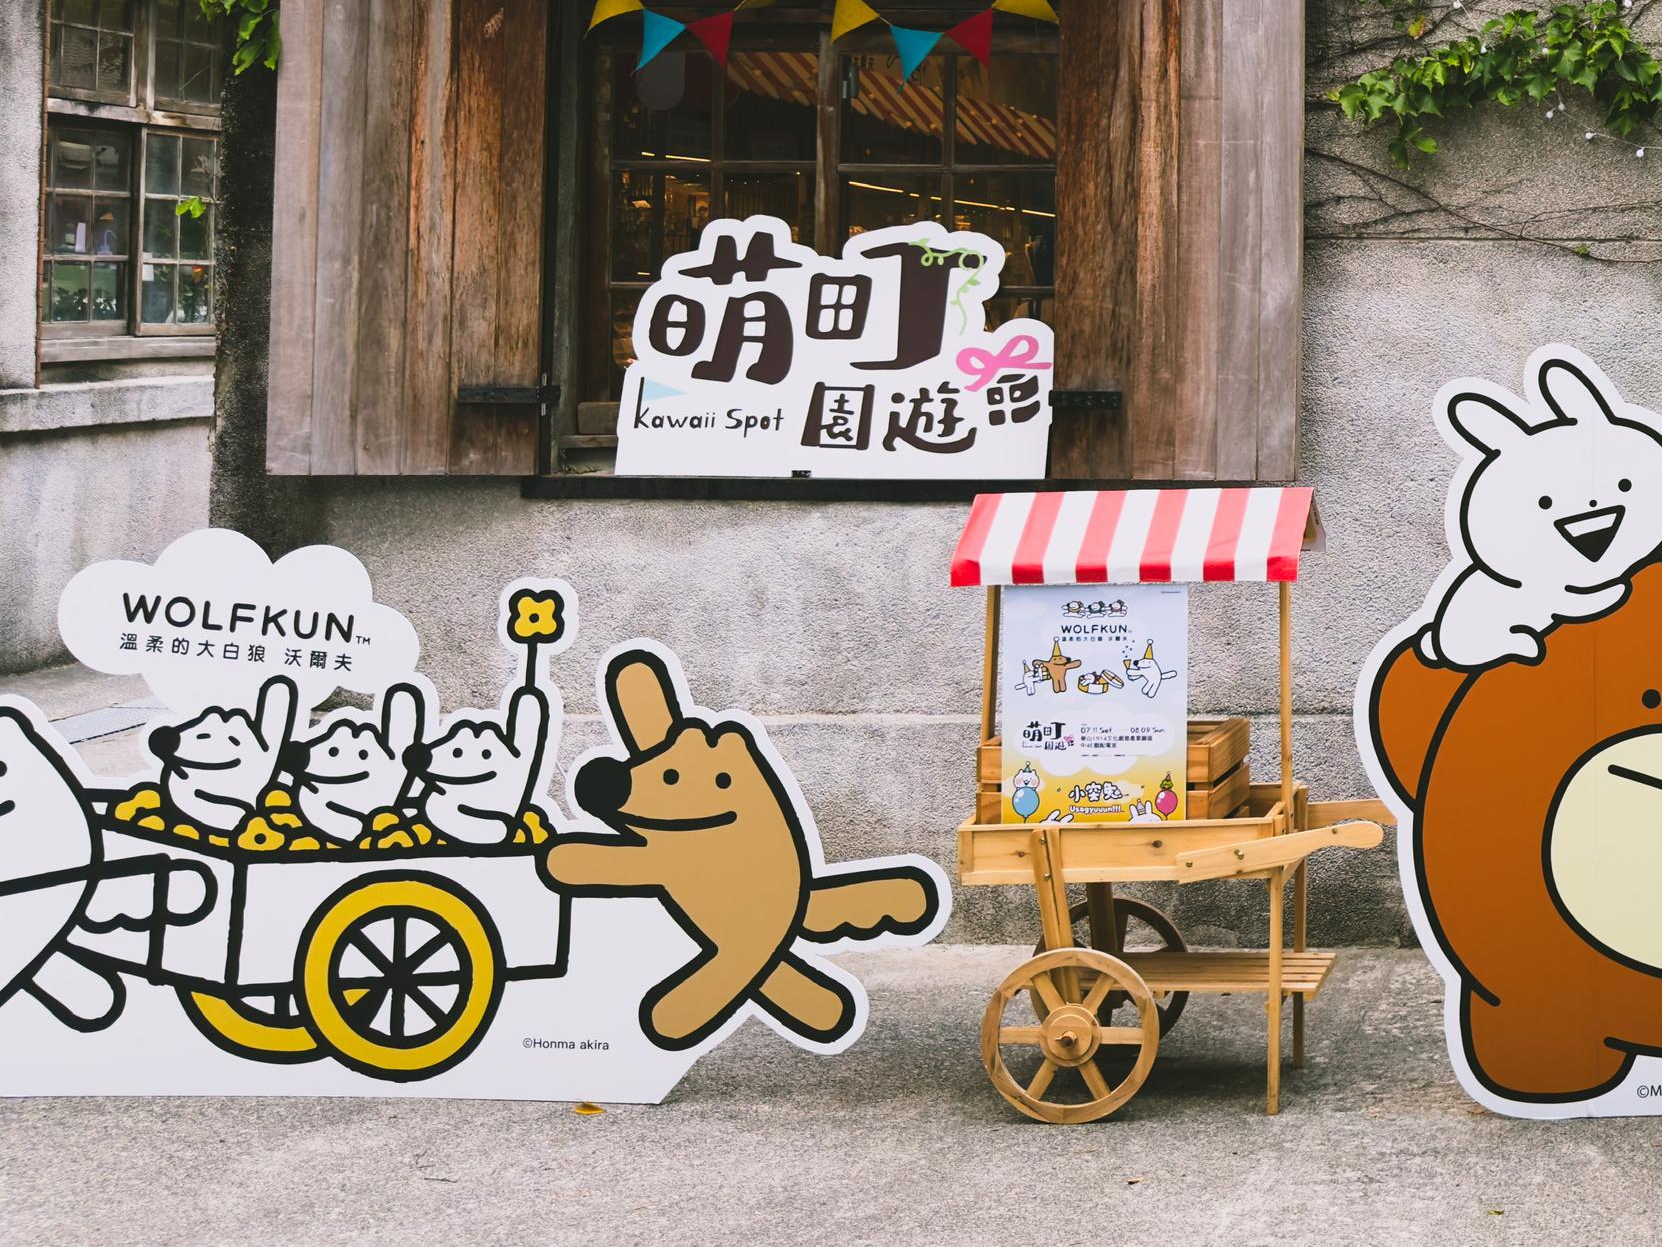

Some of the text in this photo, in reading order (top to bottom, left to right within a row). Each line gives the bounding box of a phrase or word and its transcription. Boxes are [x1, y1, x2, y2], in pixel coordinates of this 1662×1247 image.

[648, 231, 989, 385] 萌町
[725, 409, 784, 438] Spot
[122, 592, 355, 643] WOLFKUN
[1061, 625, 1127, 633] WOLFKUN
[119, 632, 351, 671] 溫柔的大白狼 沃爾夫
[1022, 721, 1067, 743] 萌町
[1080, 726, 1099, 734] 0711
[522, 1036, 609, 1050] ©Honma akira
